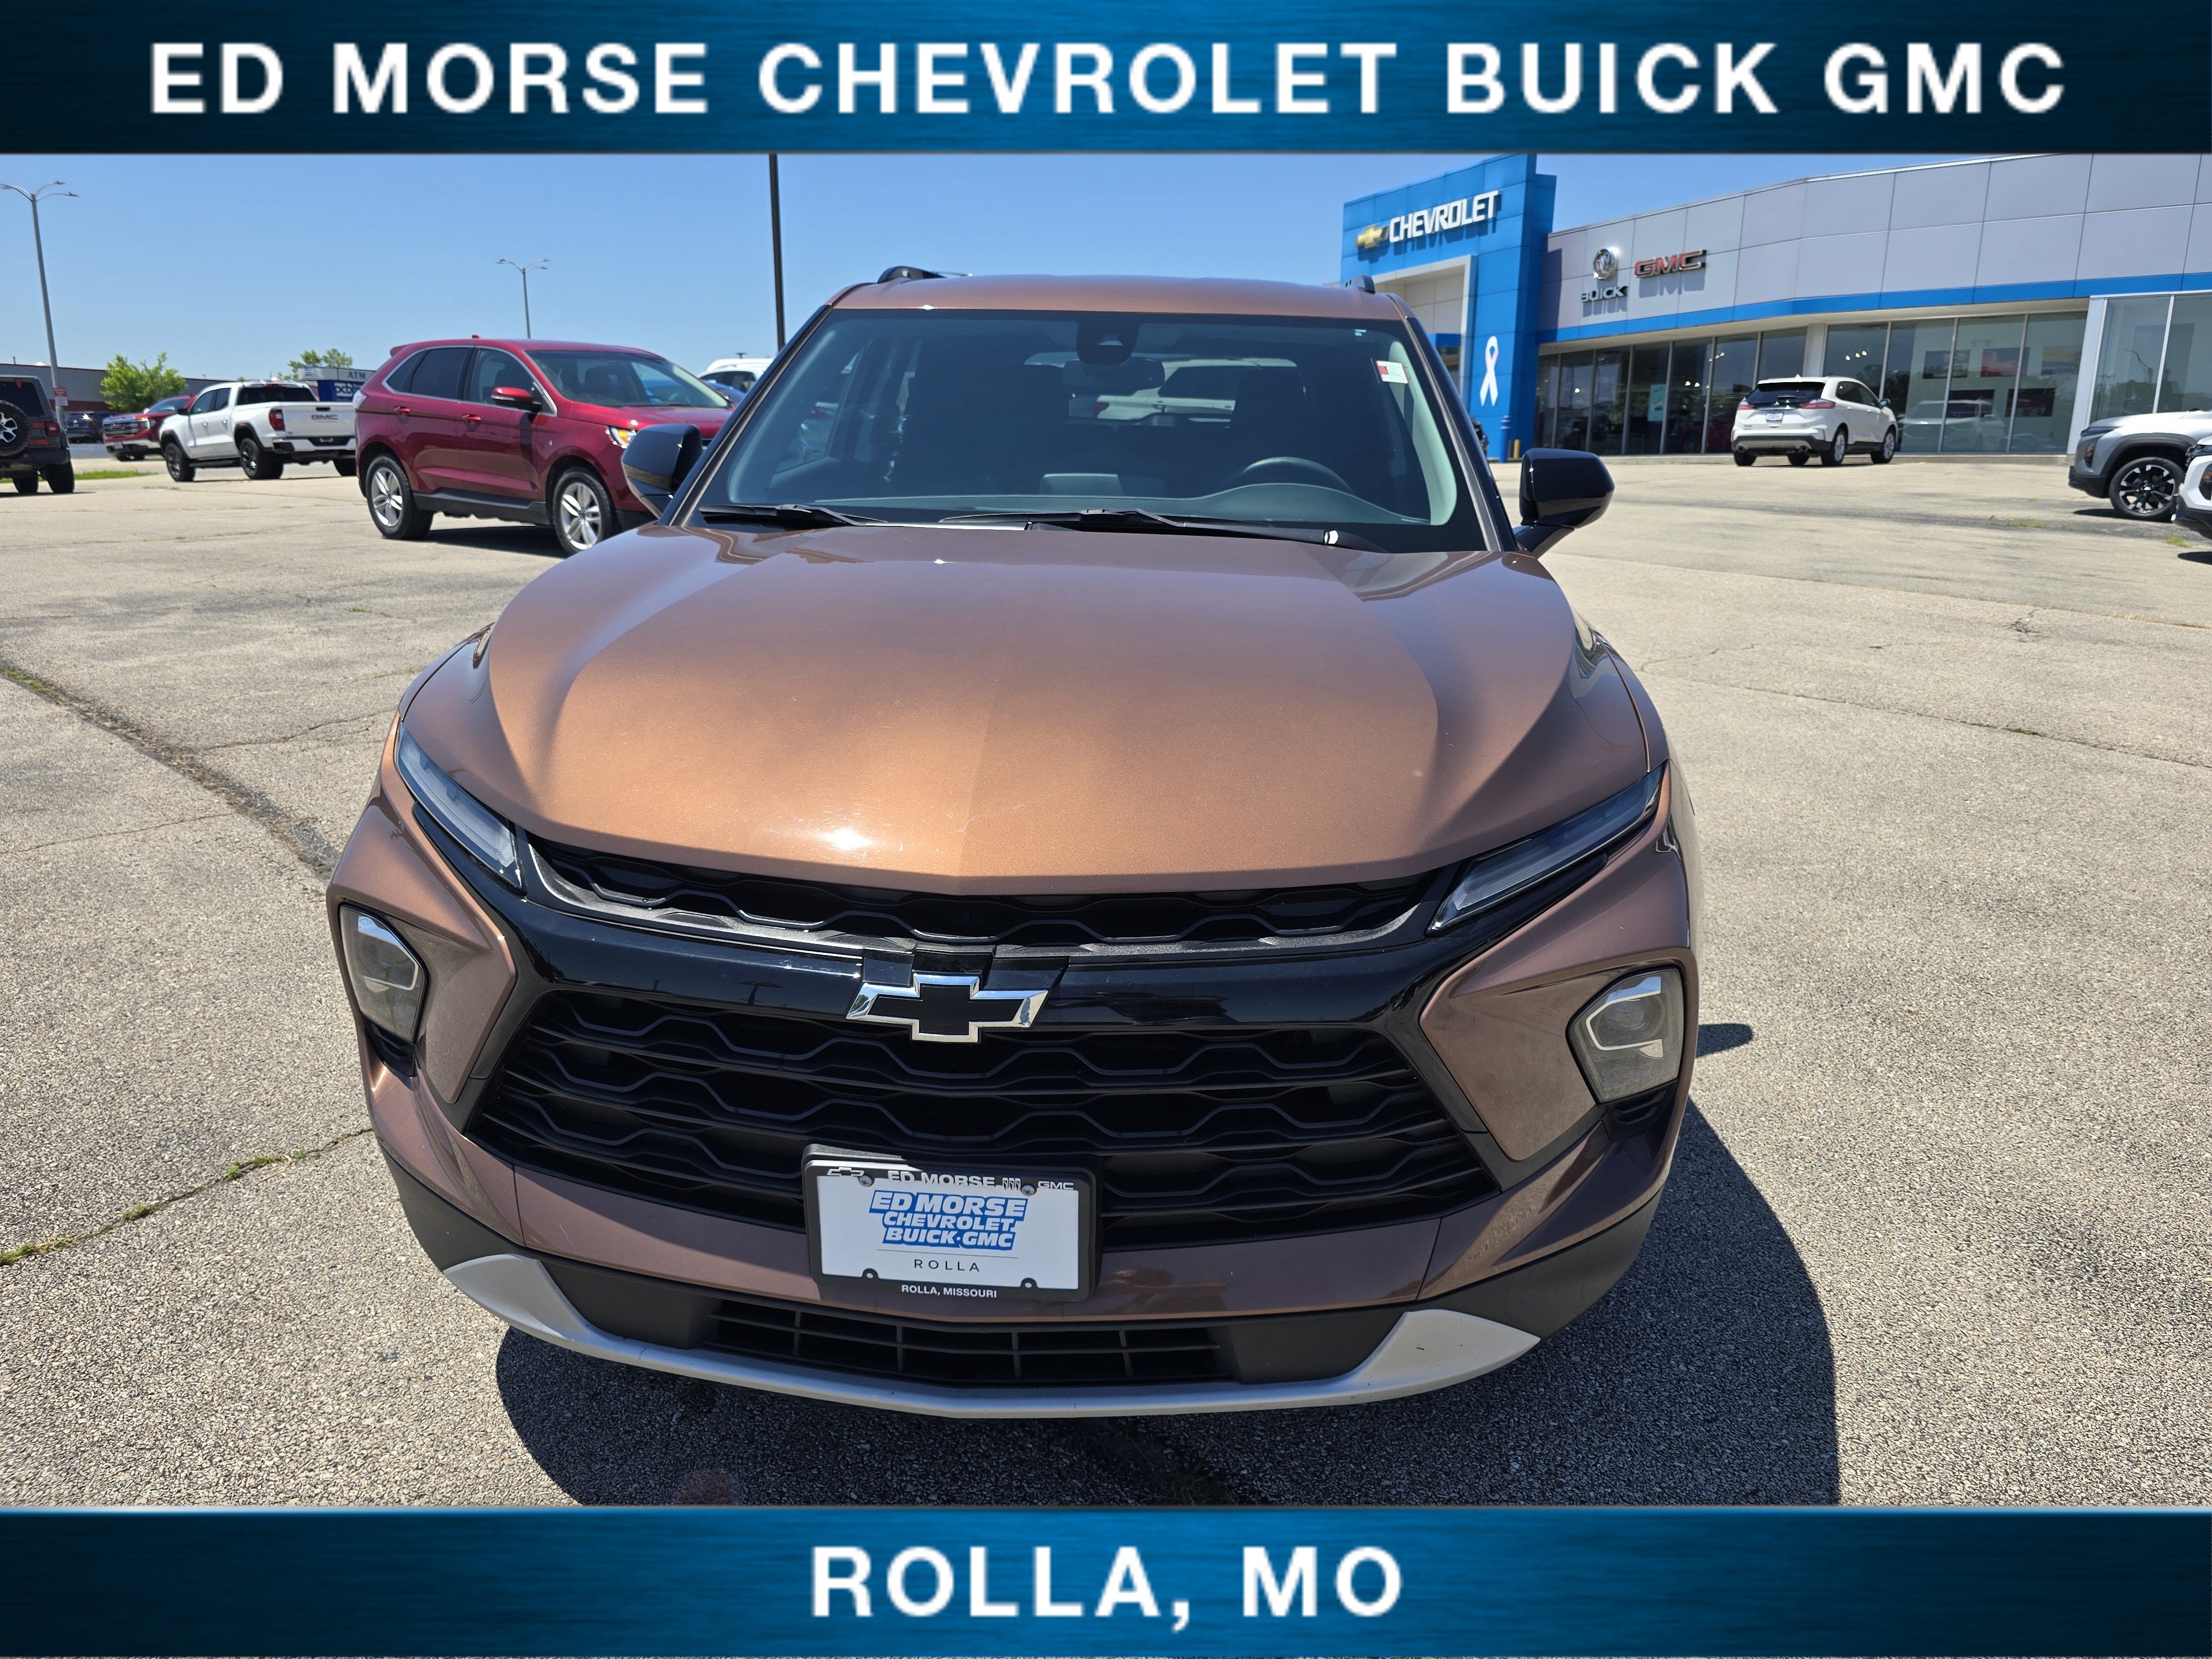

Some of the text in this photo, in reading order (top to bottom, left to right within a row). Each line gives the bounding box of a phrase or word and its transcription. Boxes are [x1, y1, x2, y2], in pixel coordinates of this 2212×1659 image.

[1389, 190, 1499, 243] CHEVROLET
[1634, 249, 1705, 278] GMC
[1580, 286, 1626, 302] BUICK
[348, 371, 366, 380] ATM
[888, 1170, 1074, 1190] ED MORSE GMC
[871, 1191, 1026, 1217] ED MORSE
[883, 1211, 1015, 1232] CHEVROLET
[914, 1259, 980, 1272] ROLLA
[901, 1284, 997, 1298] ROLLA, MISSOURI
